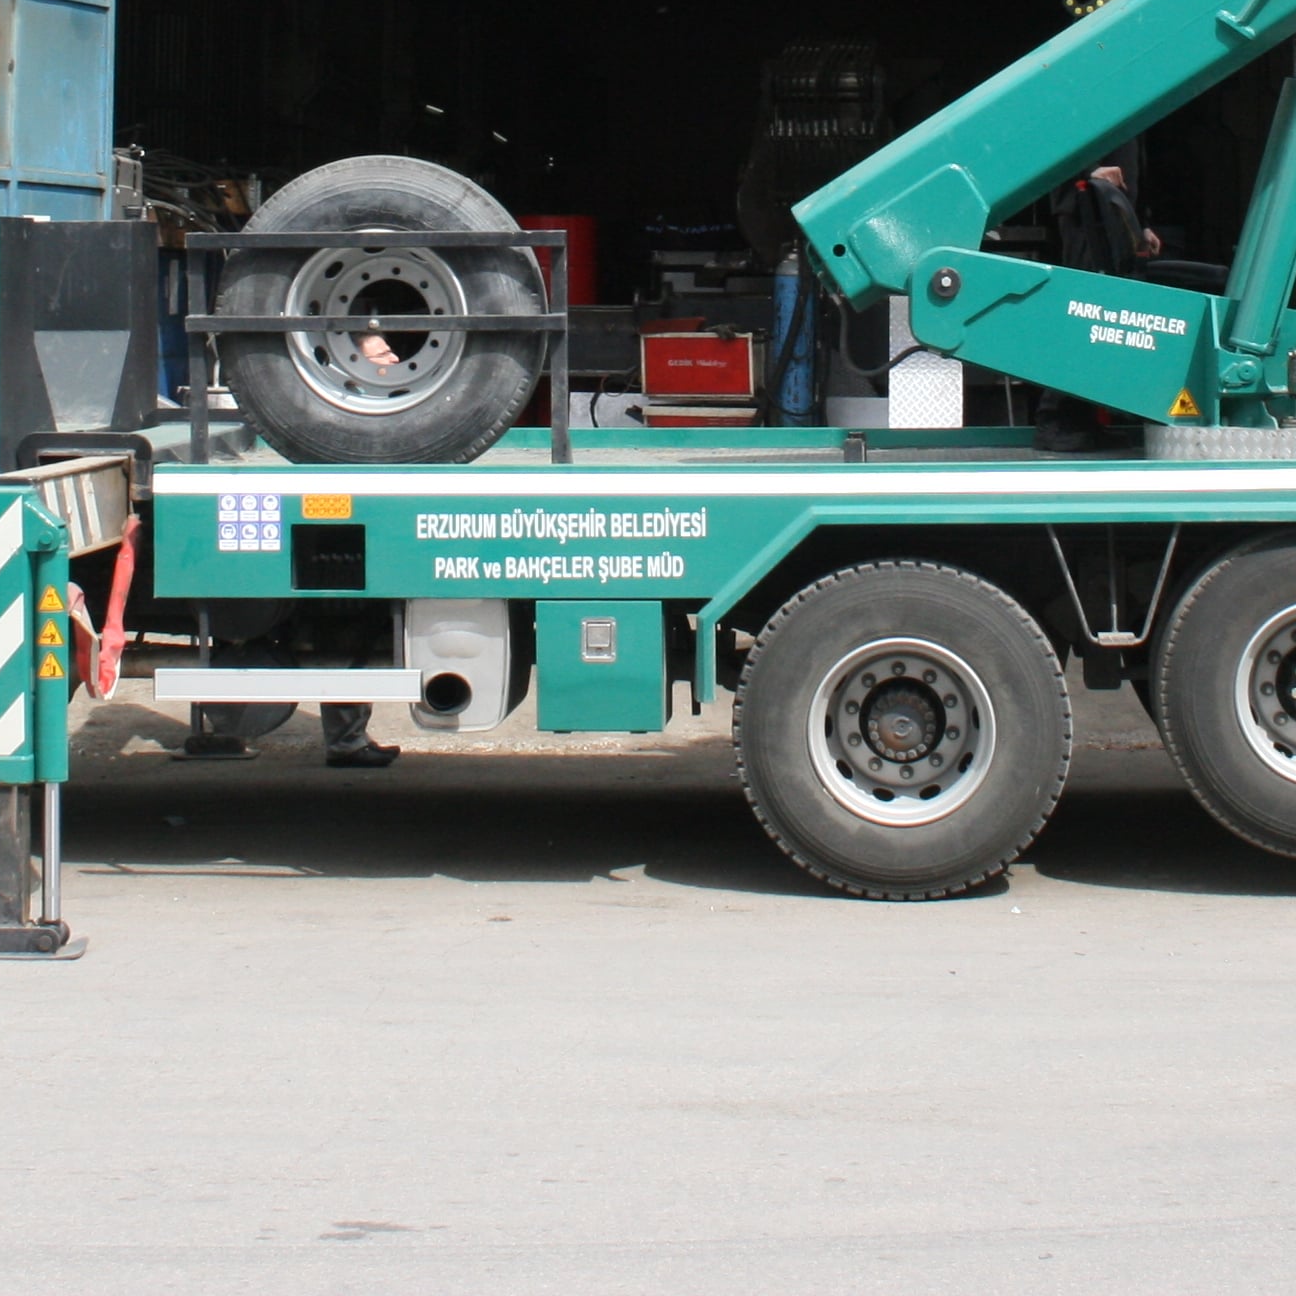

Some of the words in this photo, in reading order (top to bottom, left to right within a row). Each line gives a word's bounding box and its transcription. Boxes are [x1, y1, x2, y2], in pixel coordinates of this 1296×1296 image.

[1067, 300, 1103, 321] PARK
[1103, 309, 1118, 323] ve
[1119, 309, 1186, 336] BAHÇELER
[1089, 324, 1124, 345] ŞUBE
[1125, 330, 1156, 351] MÜD.
[417, 514, 497, 539] ERZURUM
[500, 508, 608, 544] BÜYÜKŞEHİR
[610, 507, 707, 537] BELEDİYESİ
[435, 557, 480, 579] PARK
[483, 561, 502, 579] ve
[505, 556, 595, 584] BAHÇELER
[598, 556, 643, 584] ŞUBE
[647, 552, 685, 578] MÜD
